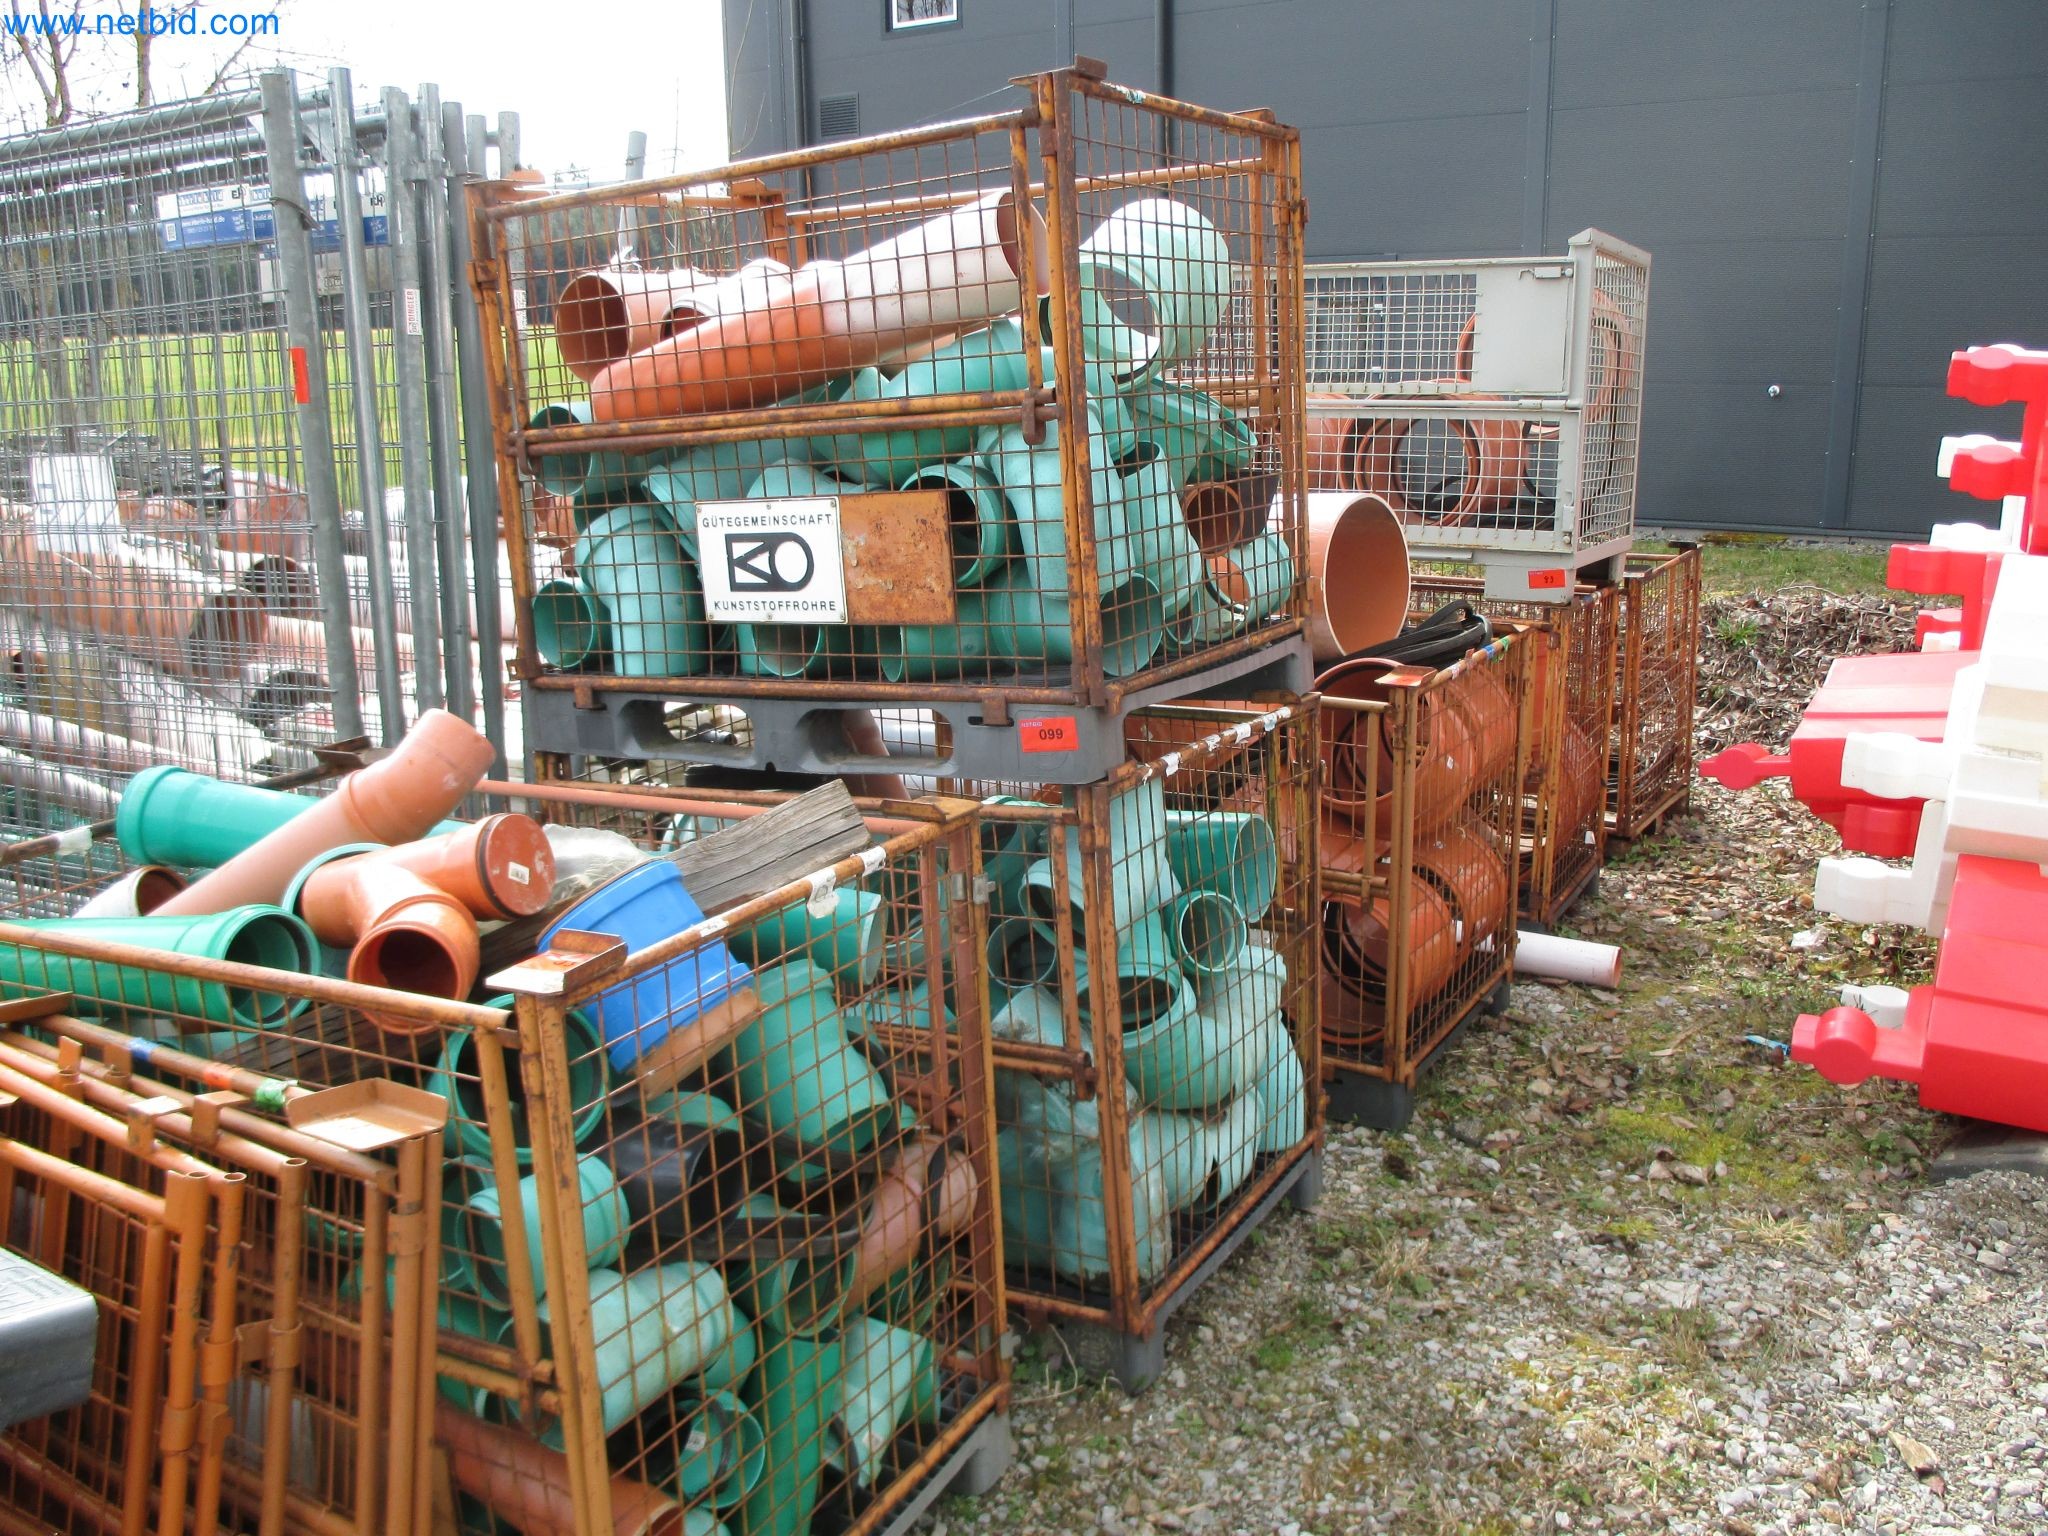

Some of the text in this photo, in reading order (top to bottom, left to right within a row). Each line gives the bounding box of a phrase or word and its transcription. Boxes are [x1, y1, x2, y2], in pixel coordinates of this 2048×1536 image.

[702, 513, 832, 528] GÜTEGEMEINSCHAFT
[714, 600, 837, 611] KUNSTSTOFFROHRE
[1039, 728, 1064, 741] 099
